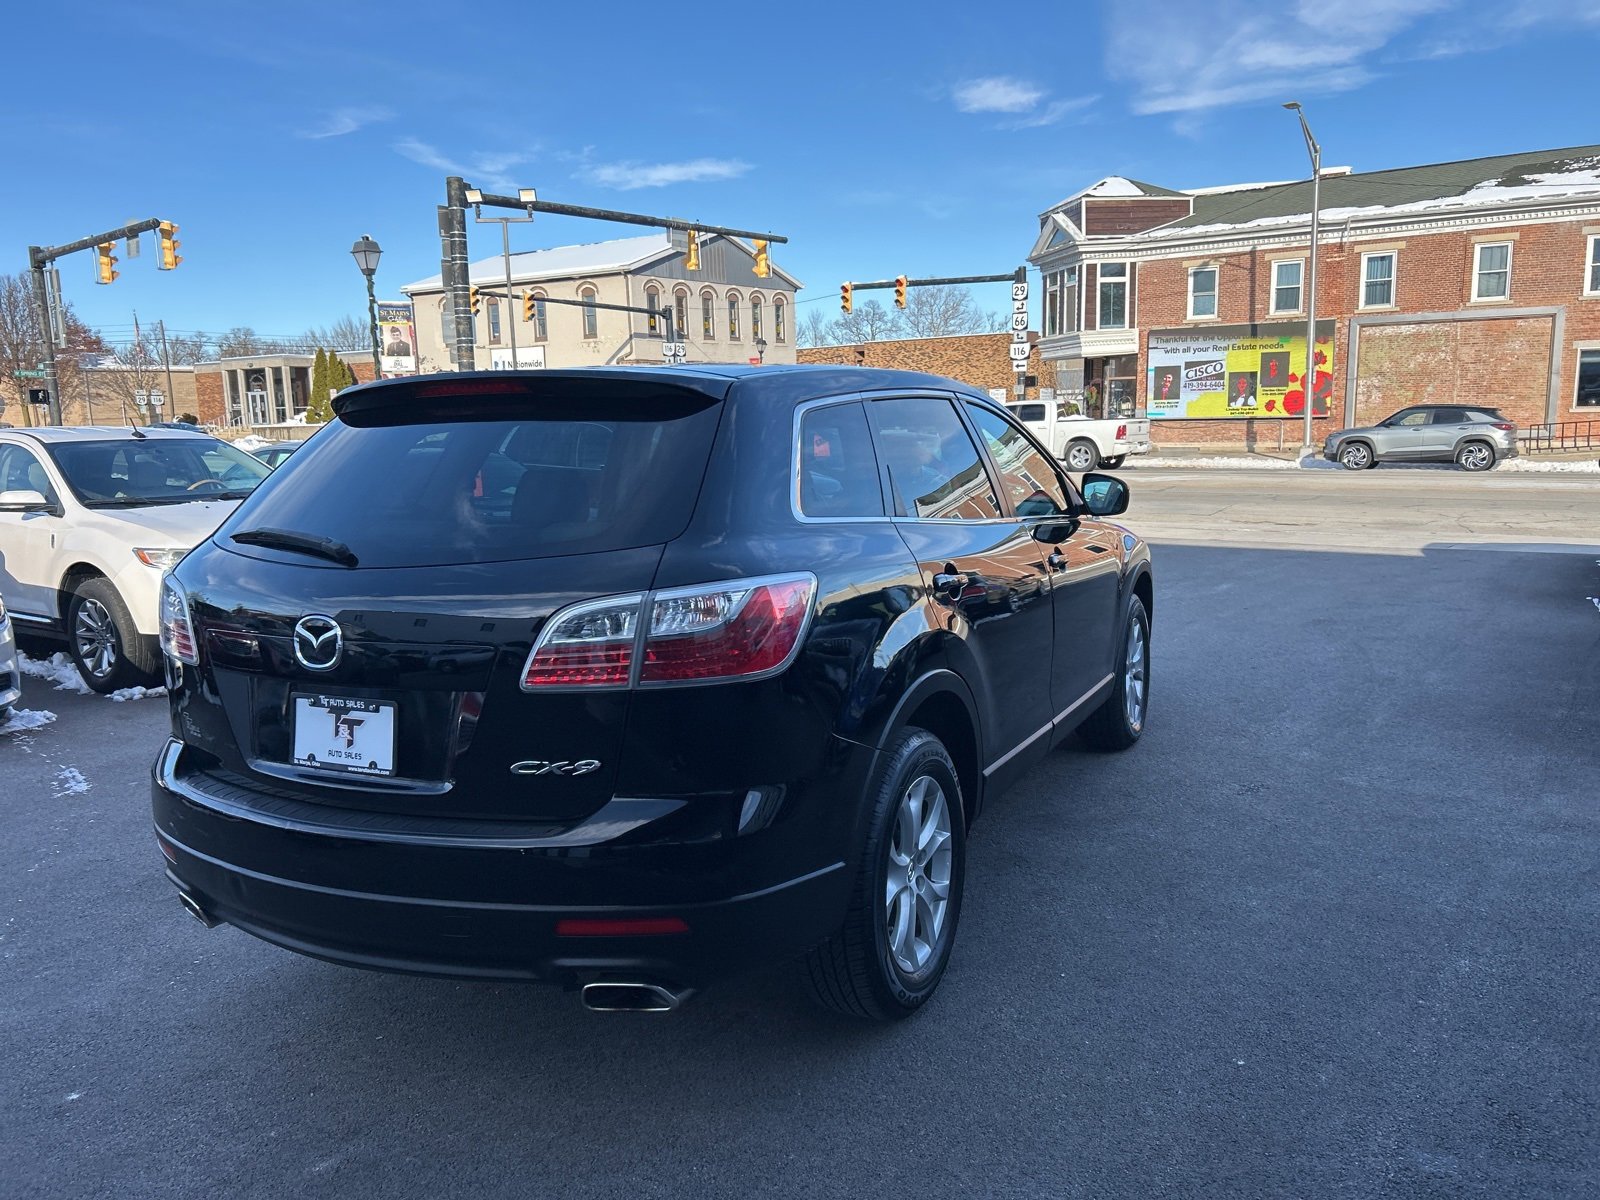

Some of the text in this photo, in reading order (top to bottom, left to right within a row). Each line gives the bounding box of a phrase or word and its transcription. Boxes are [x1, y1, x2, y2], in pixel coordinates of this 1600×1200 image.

[1014, 286, 1026, 297] 29
[1014, 316, 1026, 327] 66
[1154, 336, 1188, 344] Thankful
[676, 345, 685, 353] 29
[1013, 347, 1026, 356] 116
[1163, 342, 1285, 355] with all your Real Estate needs
[507, 360, 543, 369] Ntionwide
[1185, 361, 1224, 380] CISCO
[137, 396, 146, 404] 29
[329, 699, 345, 708] AUTO
[346, 700, 365, 709] SALES
[328, 749, 362, 761] AUTO SALES
[510, 759, 602, 776] CX-9
